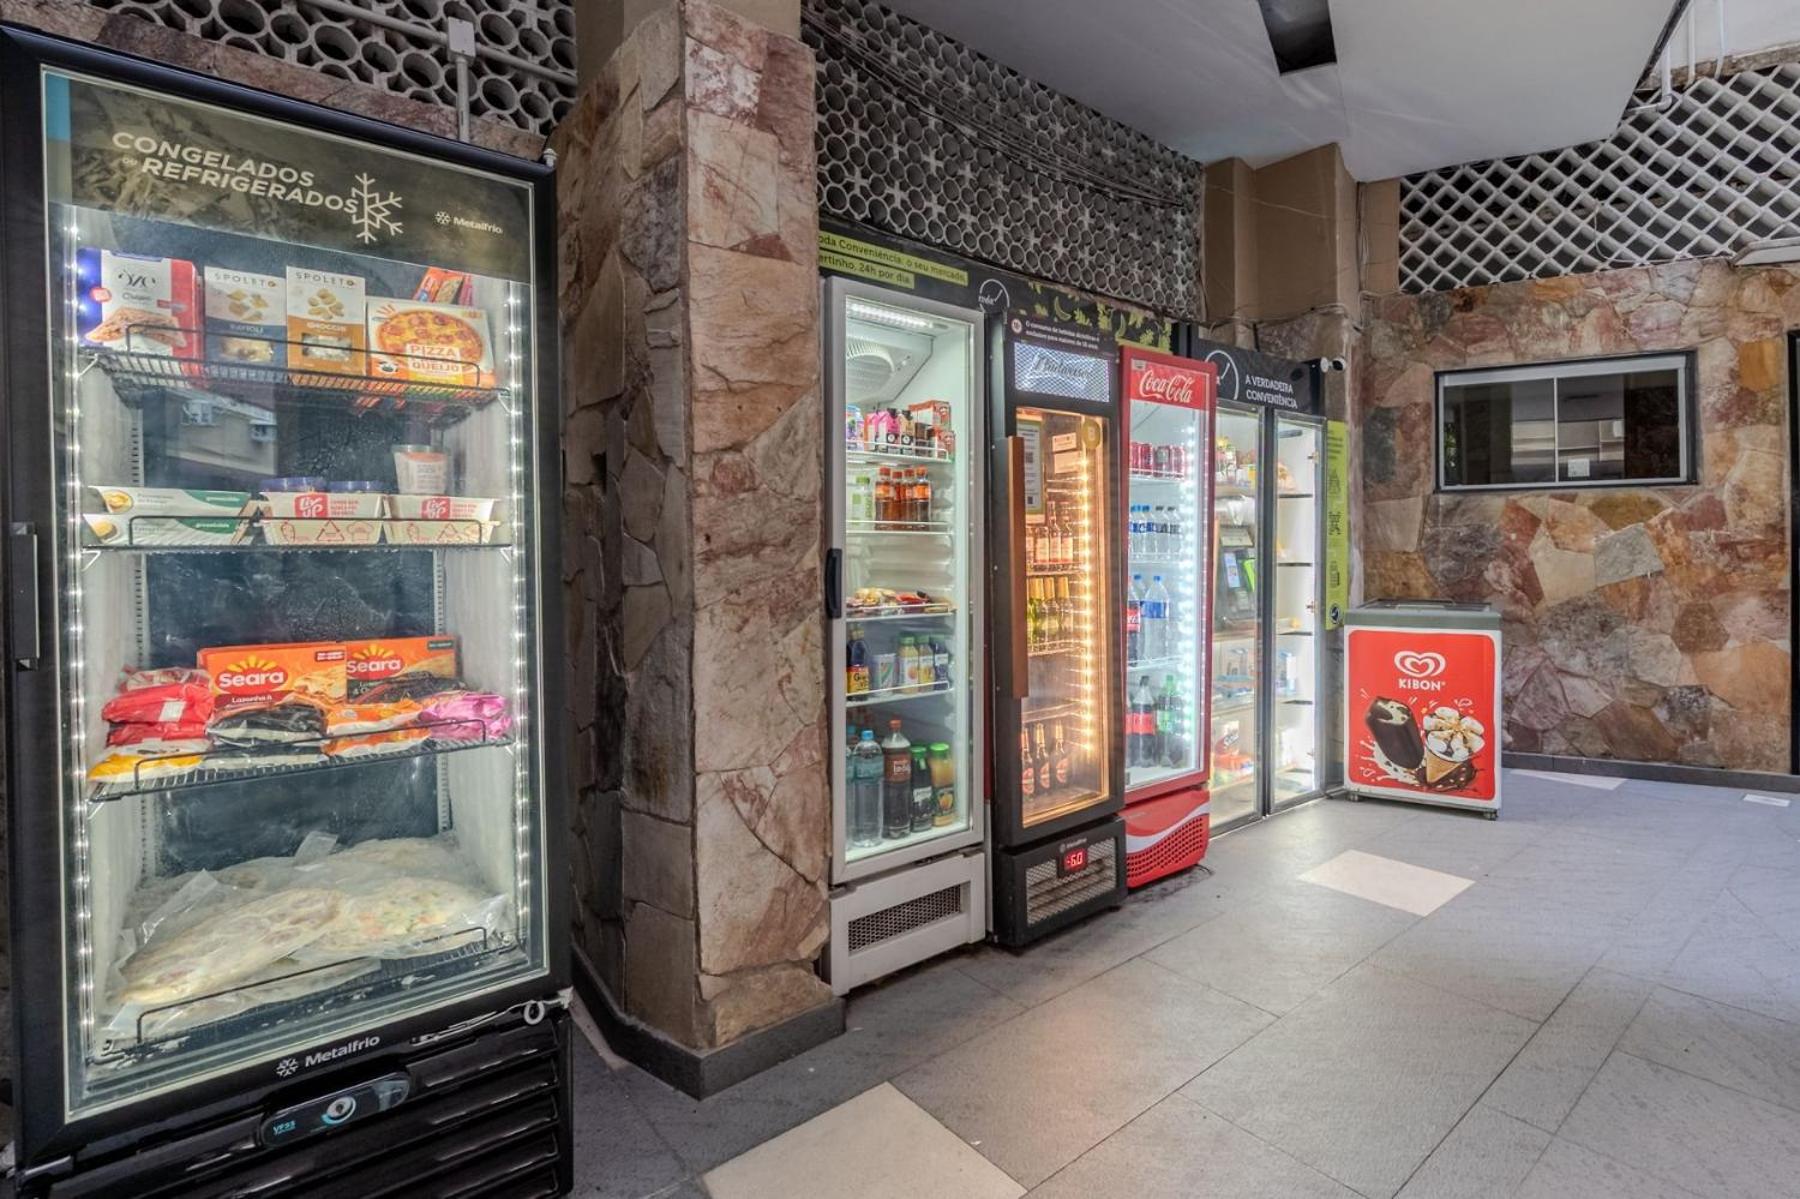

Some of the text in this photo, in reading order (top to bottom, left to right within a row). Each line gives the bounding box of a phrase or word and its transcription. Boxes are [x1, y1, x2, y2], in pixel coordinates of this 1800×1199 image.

[112, 132, 315, 187] CONGELADOS
[141, 157, 359, 213] REFRIGERADOS
[453, 216, 503, 234] Metalfrio
[819, 254, 857, 271] ertinho,
[859, 263, 876, 276] 24h
[878, 269, 896, 282] por
[914, 262, 929, 273] seu
[214, 272, 277, 288] SPOLETO
[296, 271, 355, 287] SPOLETO
[411, 345, 455, 356] PIZZA
[412, 361, 459, 372] QUEIJO
[1140, 369, 1194, 403] Coca-Cola
[1245, 374, 1294, 394] A VERDADEIRA
[1246, 389, 1298, 409] CONVENIÊNCIA
[346, 659, 401, 674] Seara
[218, 670, 284, 689] Seara
[1398, 678, 1441, 691] KIBON
[304, 1036, 380, 1067] Metalfrio
